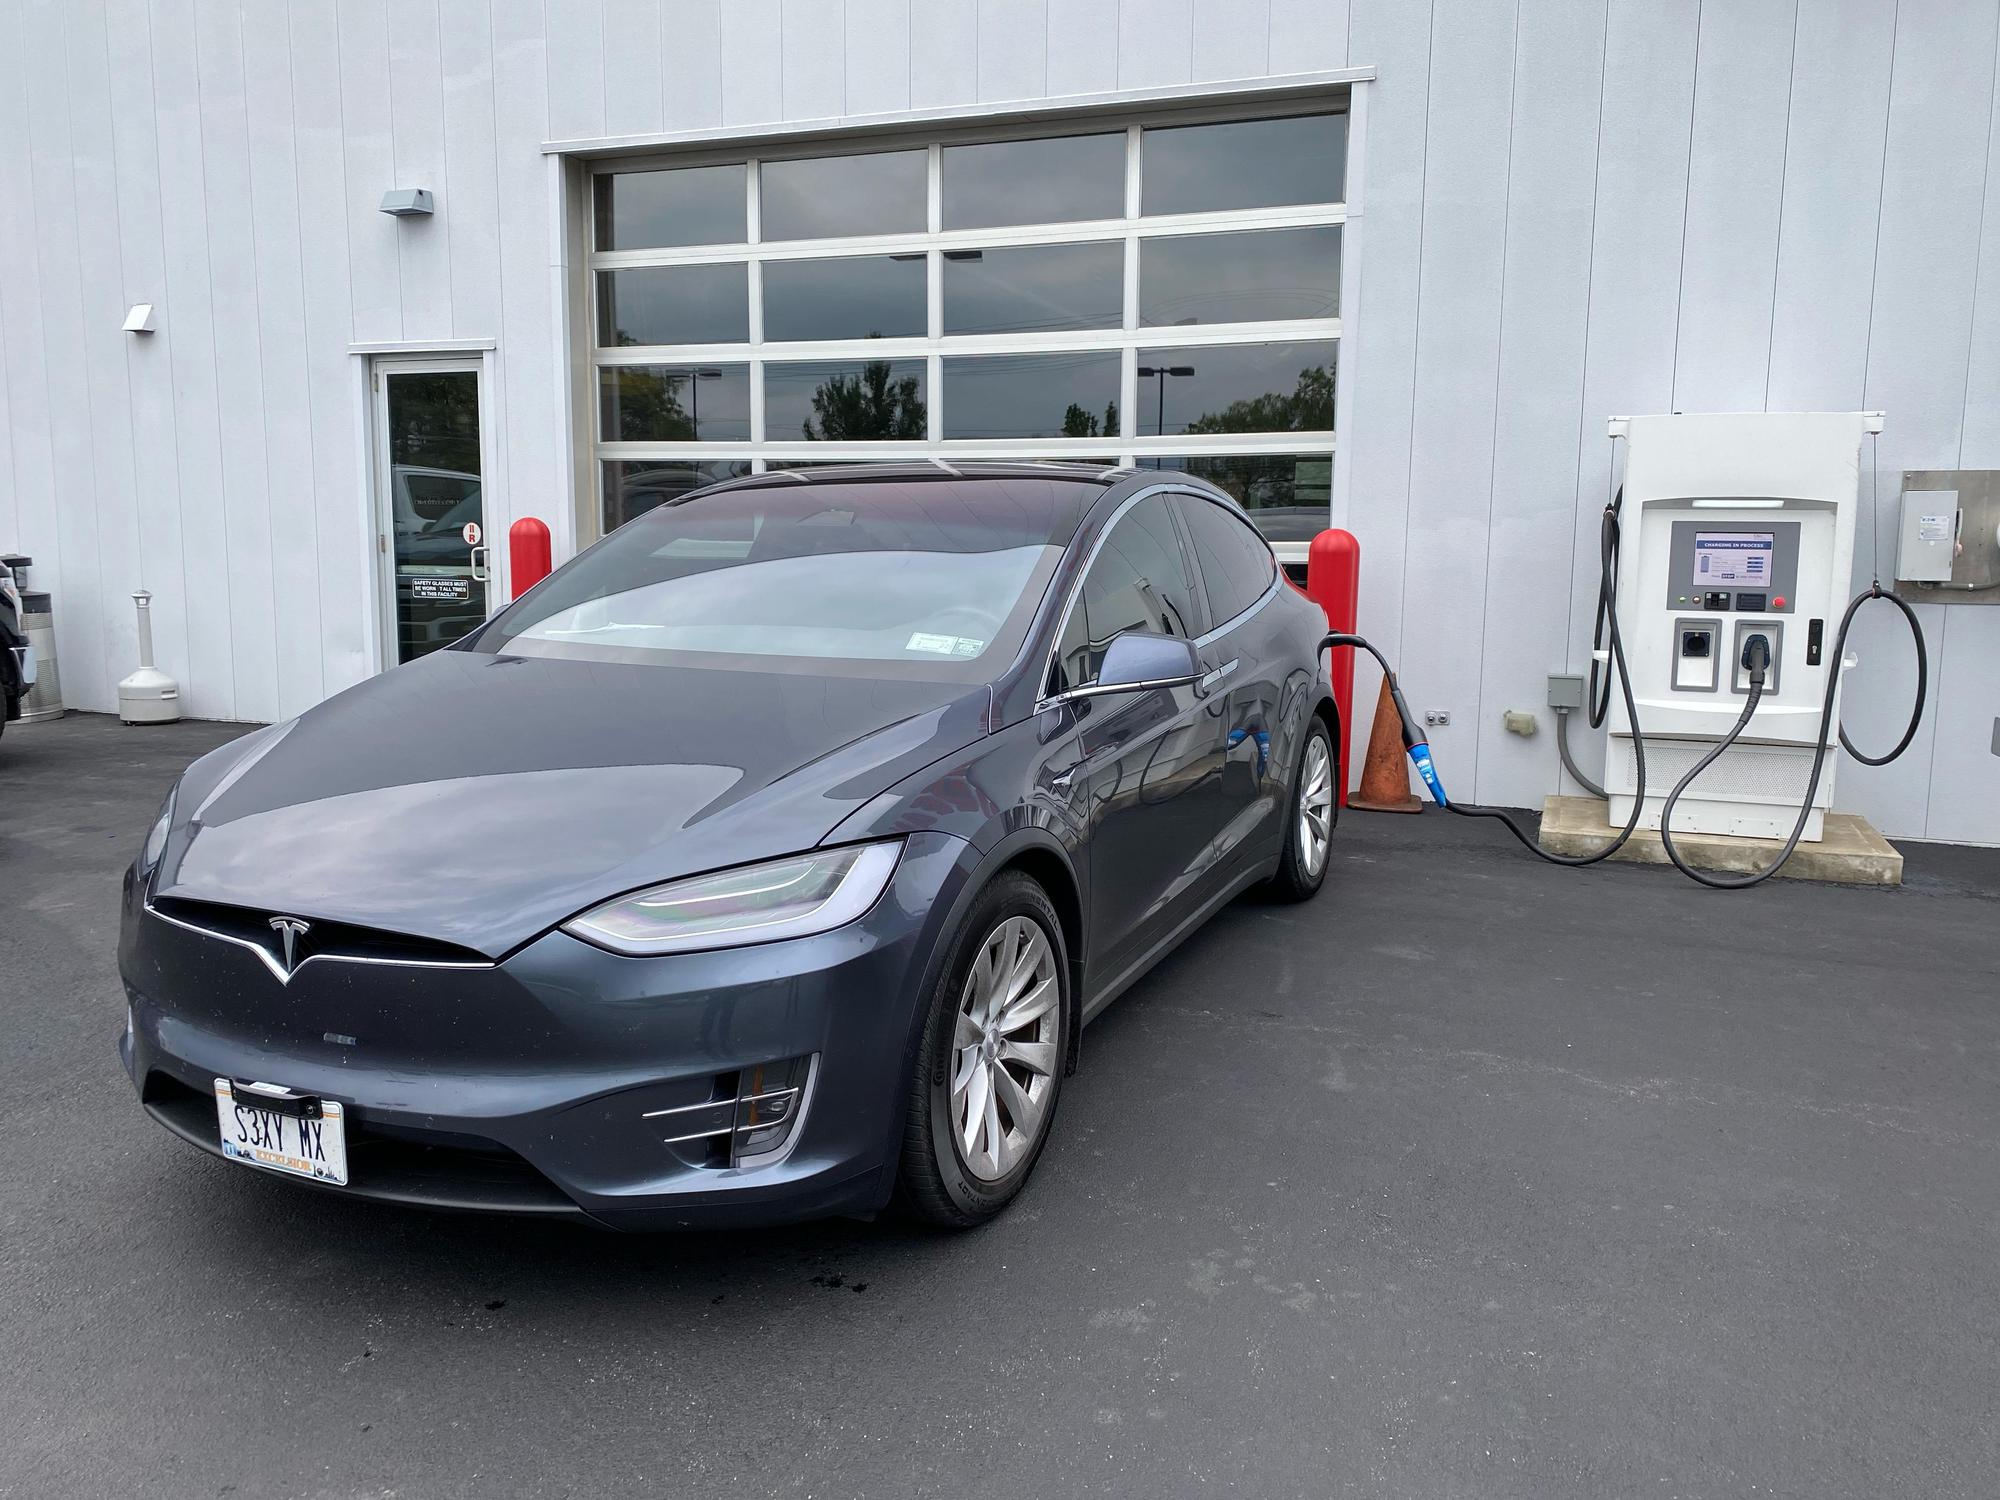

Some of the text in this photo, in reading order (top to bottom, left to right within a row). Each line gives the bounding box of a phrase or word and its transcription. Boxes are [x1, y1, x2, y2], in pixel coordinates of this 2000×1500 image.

[469, 534, 476, 543] R
[234, 1104, 326, 1162] S3XY MX
